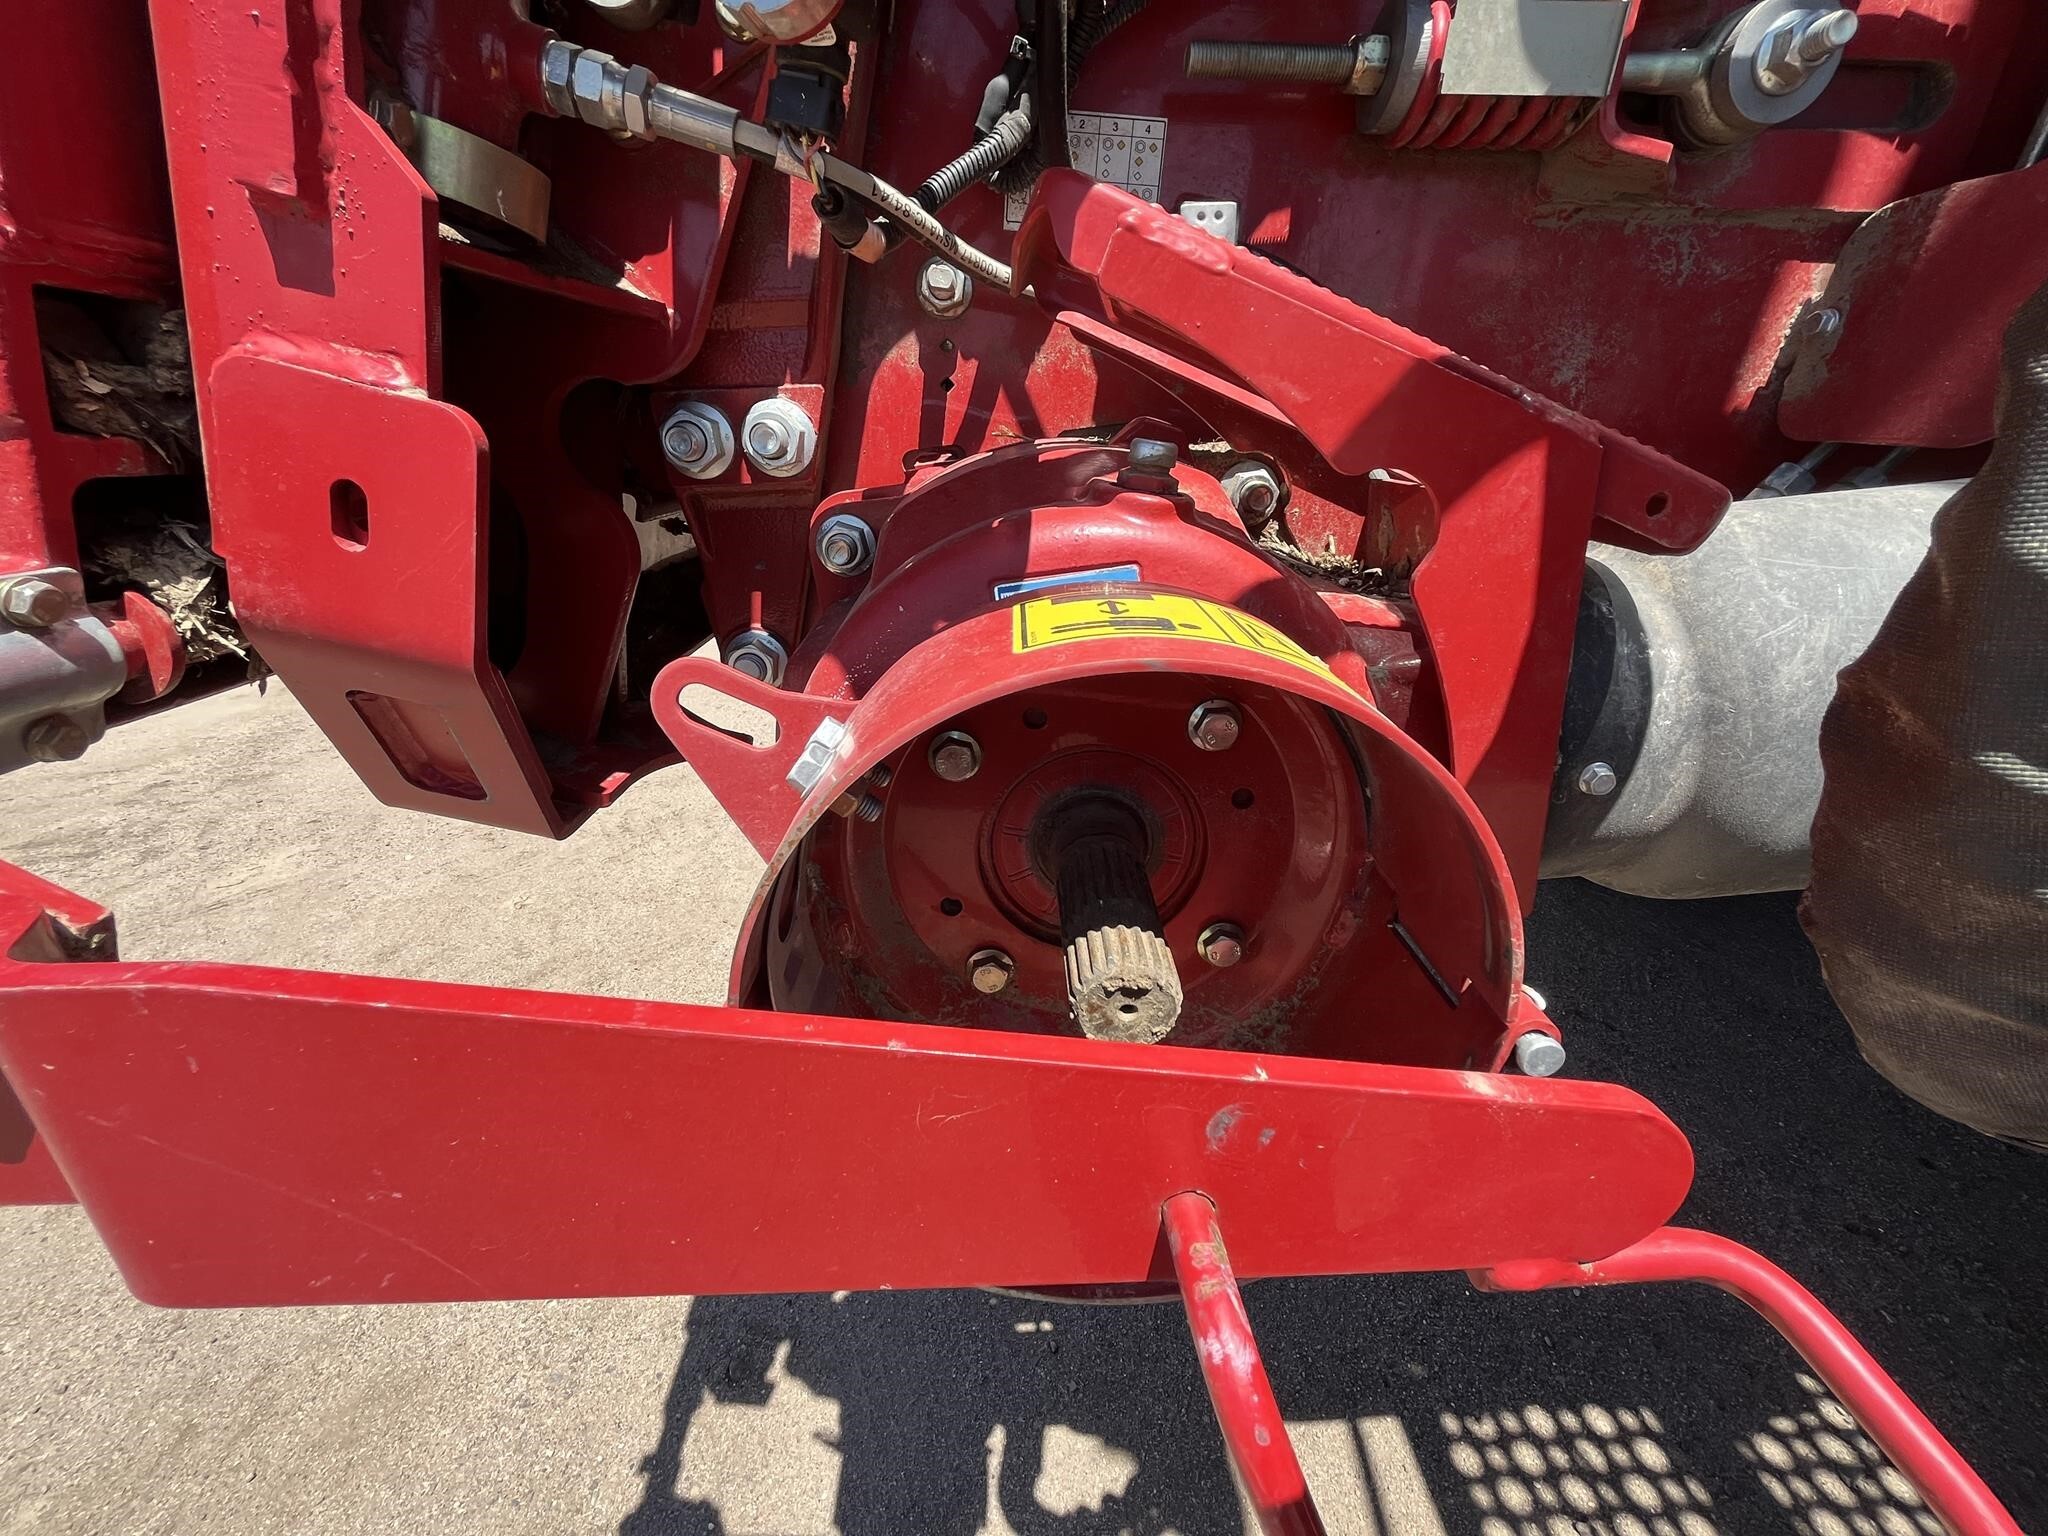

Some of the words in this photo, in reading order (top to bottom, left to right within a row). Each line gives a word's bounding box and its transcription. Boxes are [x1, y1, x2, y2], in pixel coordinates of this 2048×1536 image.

[1079, 119, 1086, 129] 2
[1112, 122, 1119, 132] 3
[1145, 124, 1151, 135] 4
